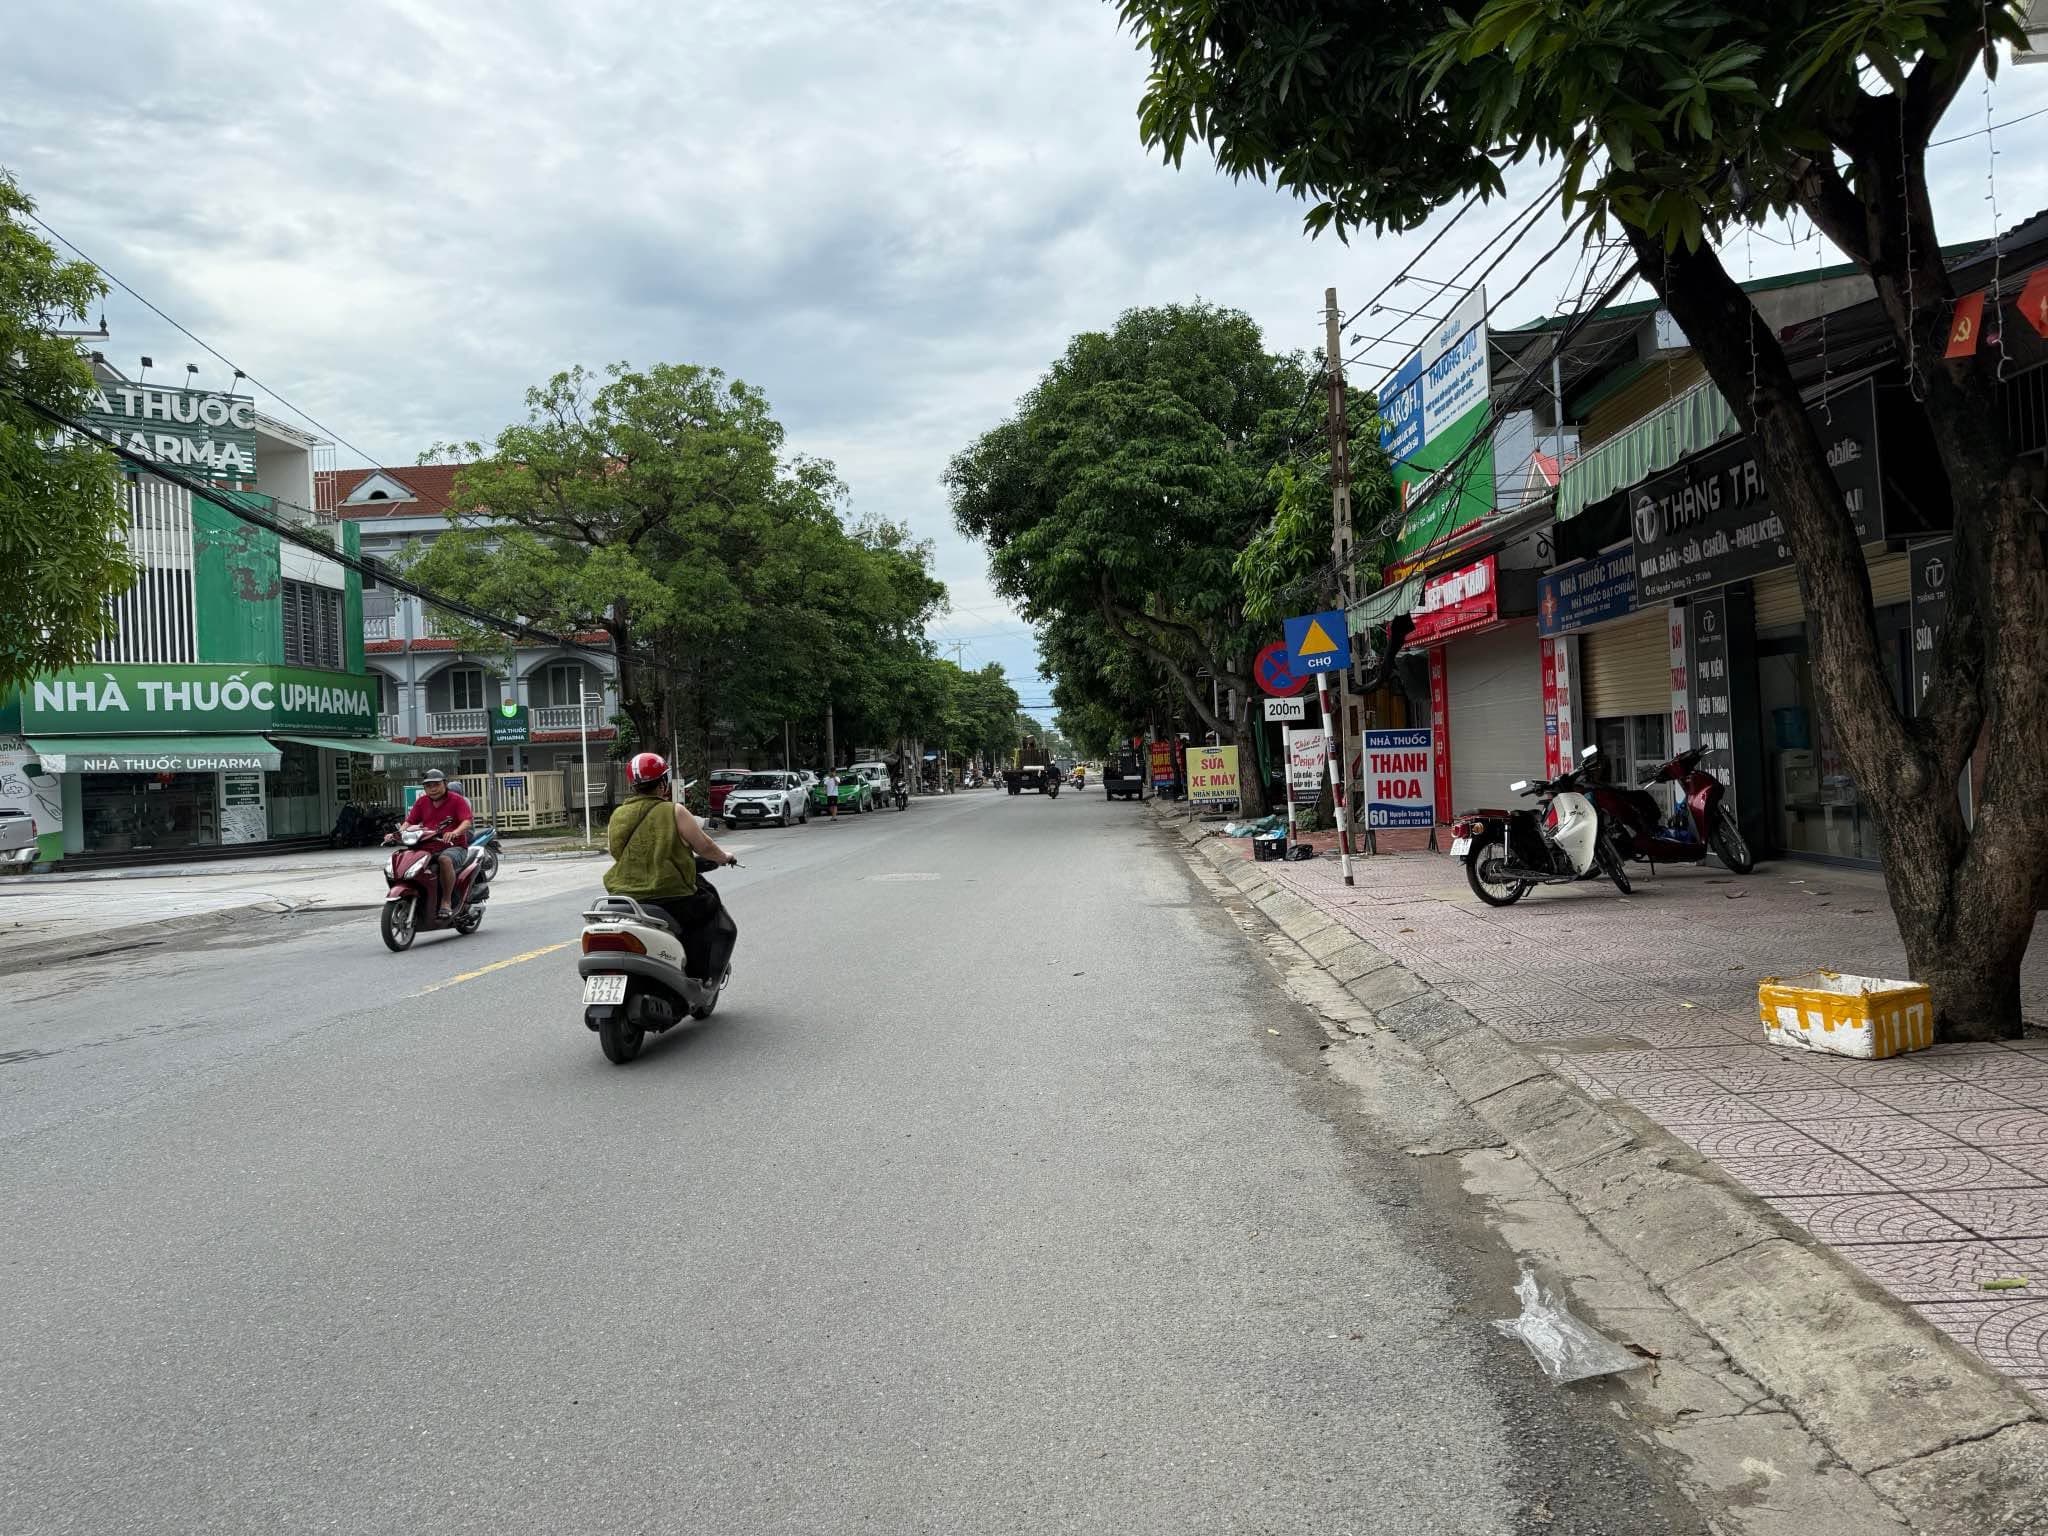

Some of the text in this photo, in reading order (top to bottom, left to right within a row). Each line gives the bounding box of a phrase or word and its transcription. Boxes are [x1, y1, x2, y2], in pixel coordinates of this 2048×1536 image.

[116, 386, 256, 430] THUỐC
[1826, 438, 1860, 467] obile
[1640, 559, 1658, 579] MUA
[1683, 536, 1702, 566] SỬA
[1703, 531, 1730, 559] CHỮA
[1736, 523, 1759, 549] PHỤ
[1560, 572, 1577, 597] NHÀ
[1578, 561, 1606, 591] THUỐC
[1571, 593, 1582, 610] NHÀ
[1582, 586, 1602, 606] THUỐC
[1602, 585, 1613, 602] ĐẠT
[1916, 618, 1933, 652] SỬA
[1307, 655, 1332, 668] CHỢ
[1698, 656, 1724, 682] PHỤ KIỆN
[1671, 658, 1687, 691] THUỐC
[33, 670, 371, 717] NHÀ THUỐC UPHARMA
[1269, 703, 1300, 716] 200m
[1697, 694, 1728, 717] ĐIỆN THOẠI
[1369, 733, 1427, 747] NHÀ THUỐC
[84, 755, 263, 771] NHÀ THUỐC UPHARMA
[1201, 754, 1224, 770] SỬA
[1370, 752, 1428, 774] THANH
[1192, 771, 1235, 788] XE MÁY
[1377, 779, 1423, 800] HOA
[1369, 809, 1388, 826] 60
